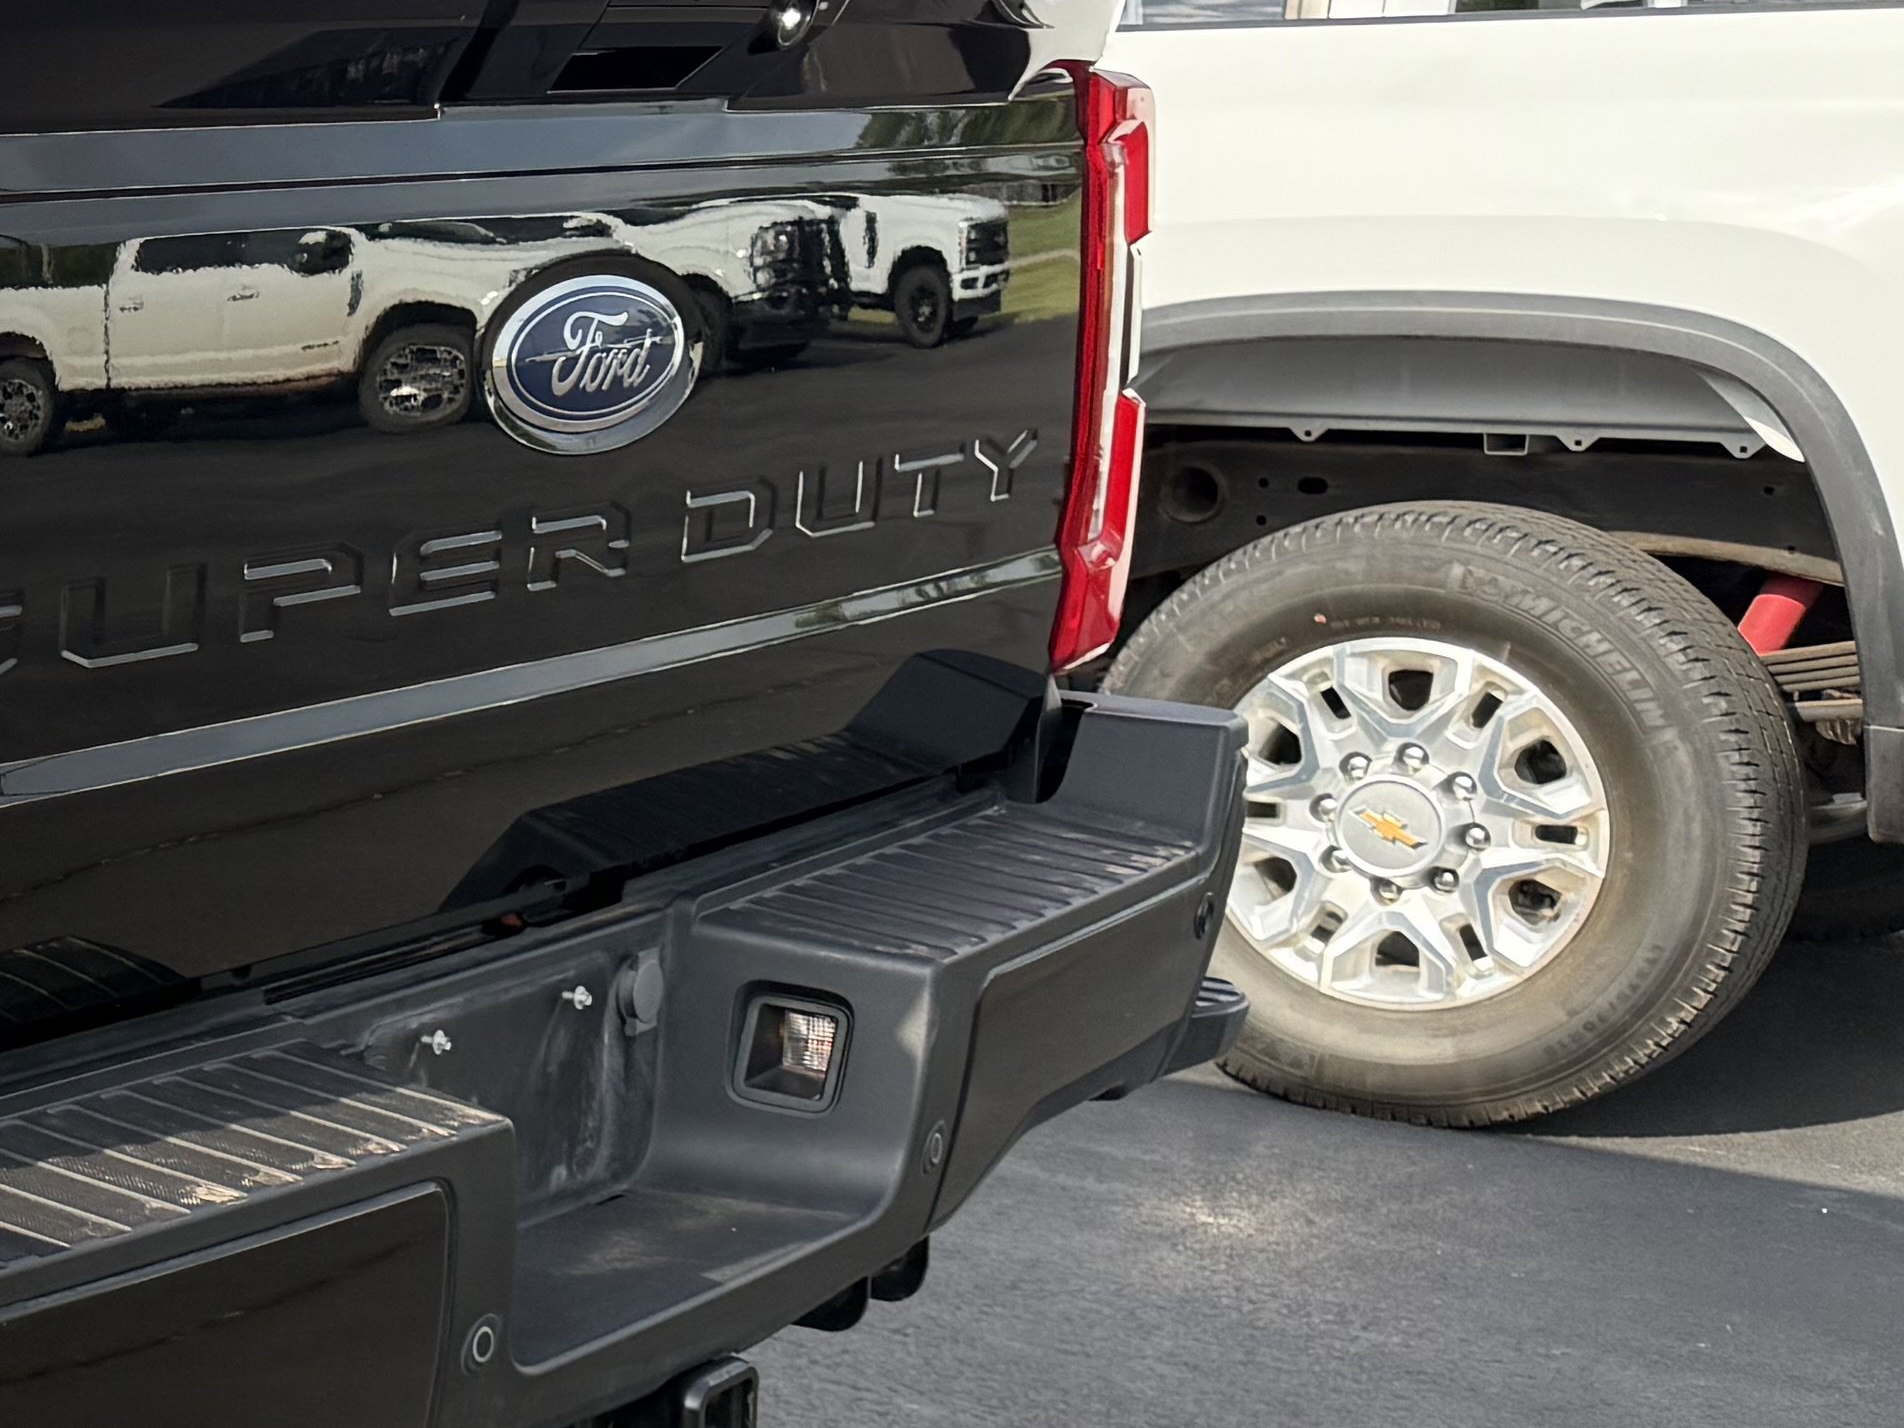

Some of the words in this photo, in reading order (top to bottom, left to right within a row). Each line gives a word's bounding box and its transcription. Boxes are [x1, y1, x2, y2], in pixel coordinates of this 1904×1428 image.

[552, 311, 651, 398] Ford
[682, 428, 1039, 564] DUTY
[1506, 587, 1670, 728] MICHELIN
